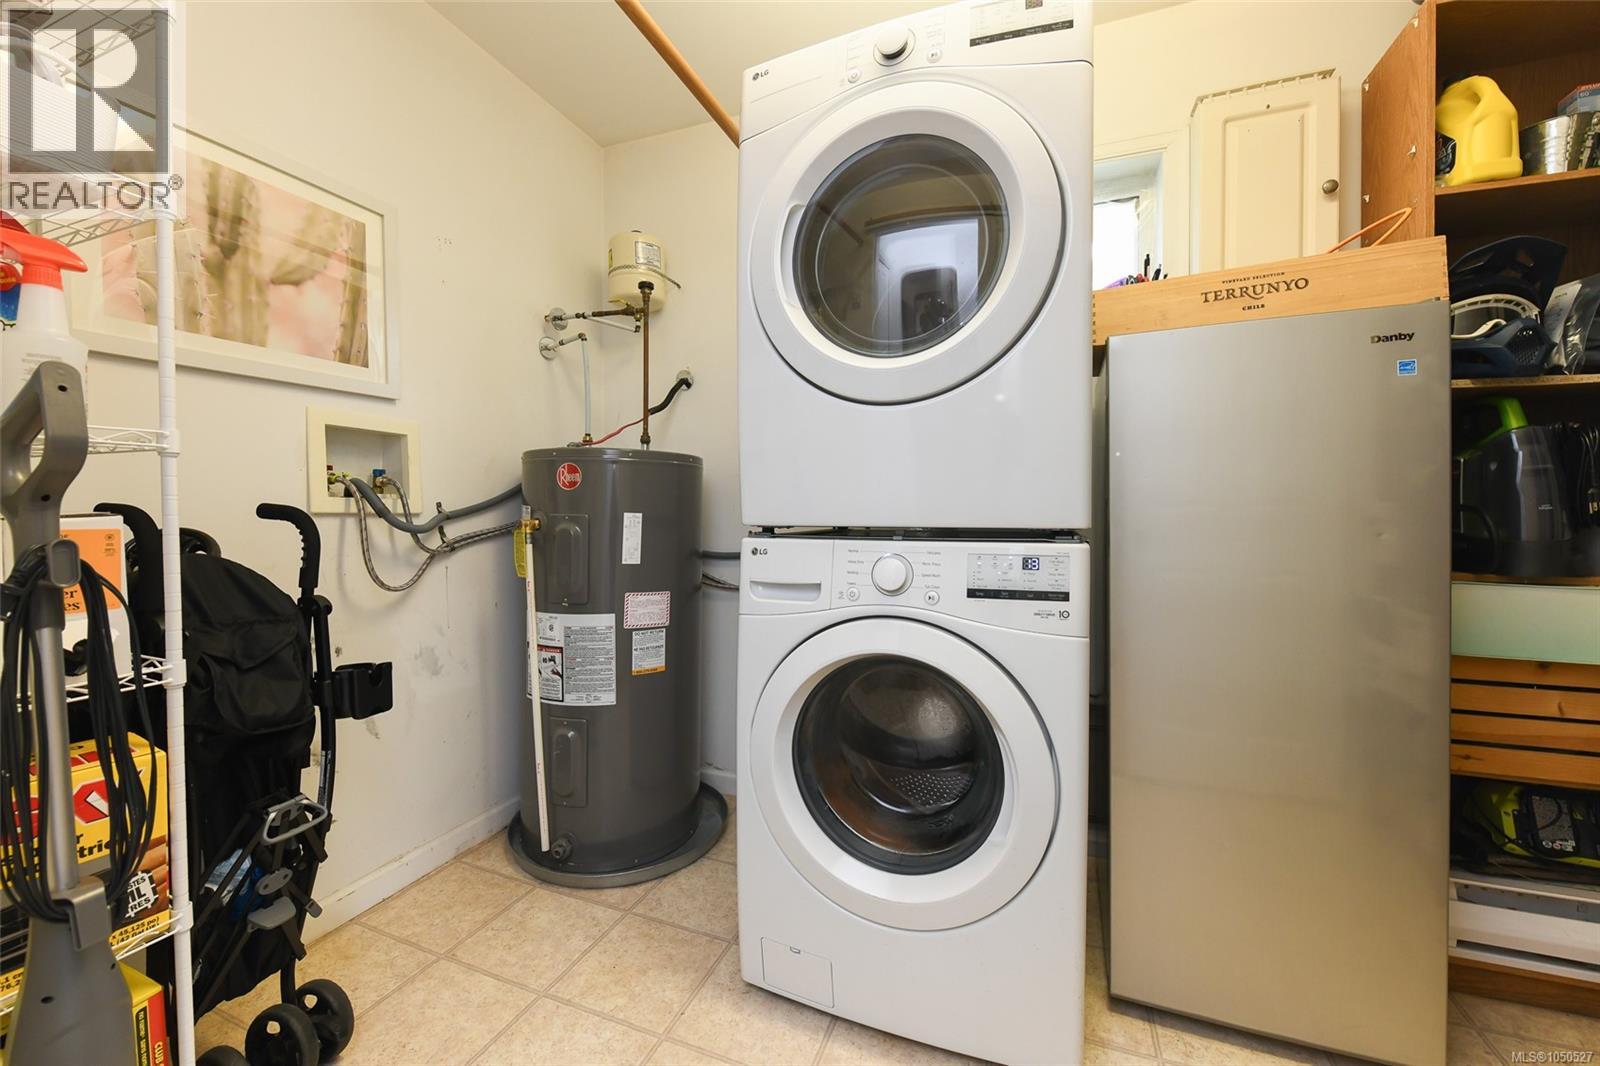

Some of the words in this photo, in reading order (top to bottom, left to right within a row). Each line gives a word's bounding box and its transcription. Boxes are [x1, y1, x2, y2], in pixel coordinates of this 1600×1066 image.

[761, 69, 769, 78] LG
[1222, 276, 1251, 284] VINEYARD
[1252, 272, 1286, 280] SELECTION
[1200, 277, 1310, 304] TERRUNYO
[1370, 332, 1415, 344] Danby
[154, 1041, 165, 1065] CLUB
